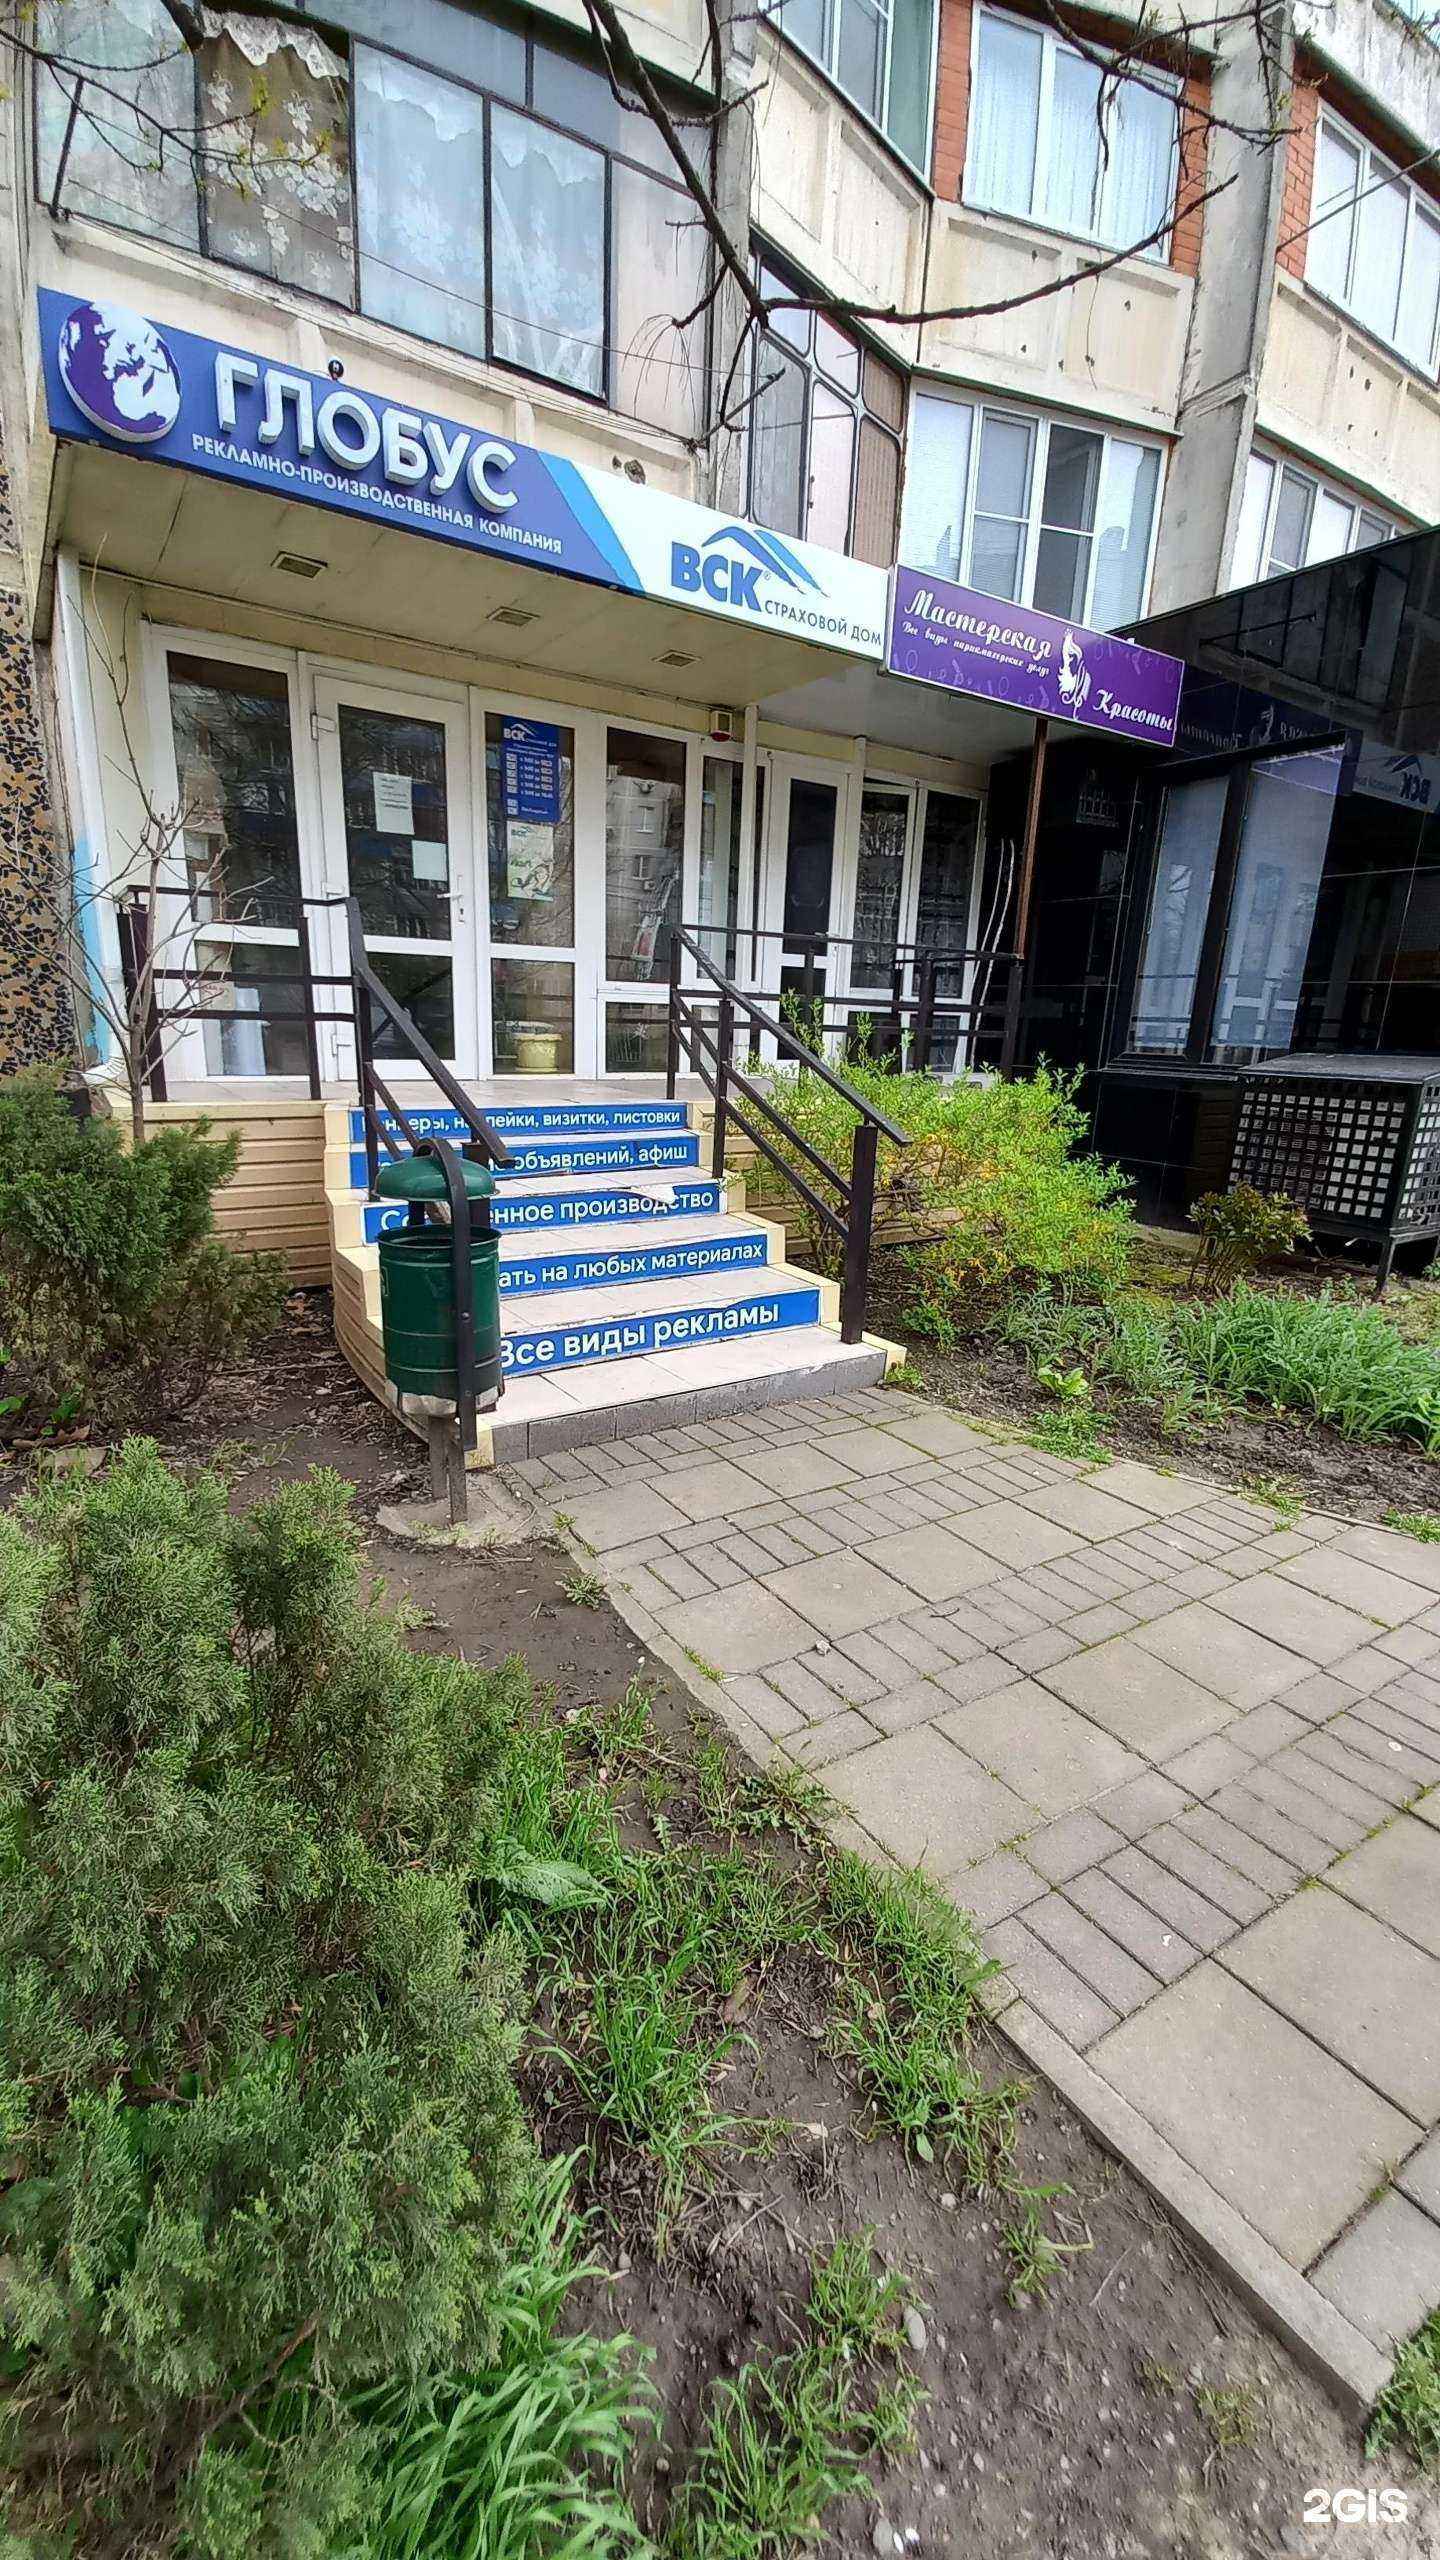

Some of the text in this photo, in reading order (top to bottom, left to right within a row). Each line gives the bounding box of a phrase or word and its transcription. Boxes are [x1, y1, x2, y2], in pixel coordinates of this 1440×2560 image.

[214, 351, 519, 514] ГЛОБУС
[192, 434, 562, 554] РЕКЛАМНО-ПРОИЗВОДСТВЕННАЯ КОМПАНИЯ
[671, 541, 762, 612] ВСК
[764, 599, 881, 646] СТРАХОВОЙ ДОМ
[903, 621, 918, 636] Все
[904, 589, 1052, 661] Мастерская
[1093, 689, 1175, 732] Красоты
[543, 1110, 610, 1129] визитки,
[613, 1109, 680, 1125] листовки
[638, 1143, 688, 1167] афиш
[560, 1191, 713, 1222] производство
[542, 1265, 568, 1283] на
[573, 1255, 646, 1281] любых
[651, 1242, 763, 1270] материалах
[564, 1325, 645, 1357] виды
[654, 1303, 779, 1347] рекламы
